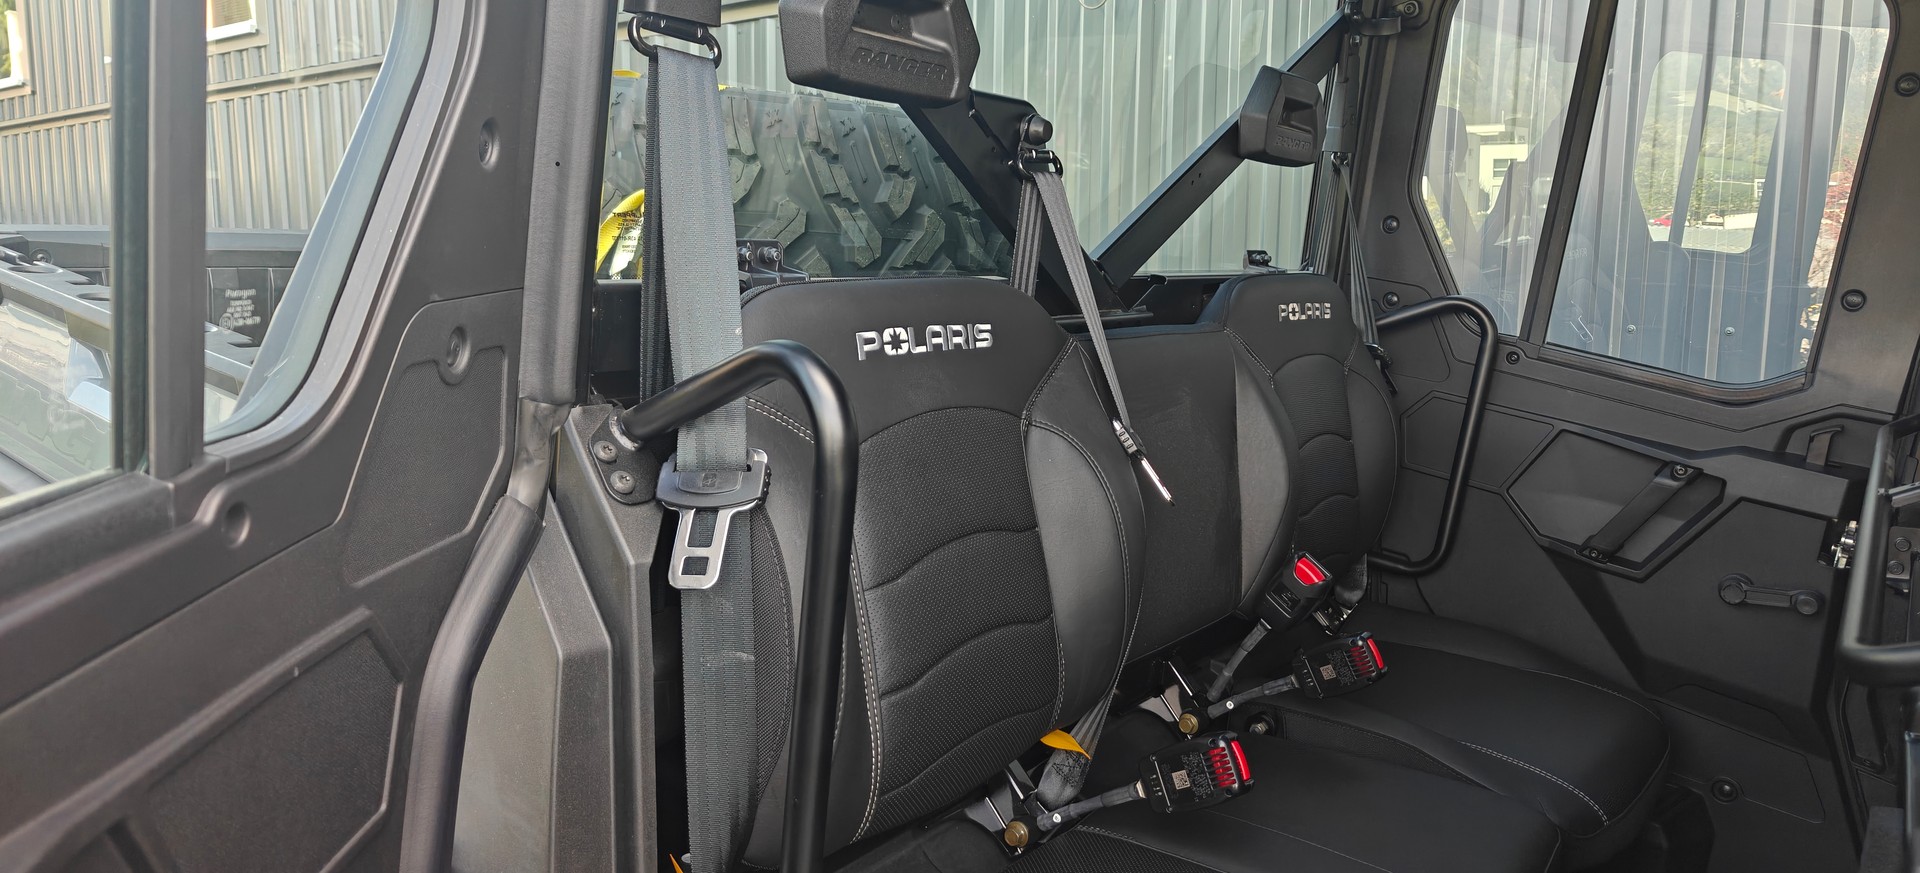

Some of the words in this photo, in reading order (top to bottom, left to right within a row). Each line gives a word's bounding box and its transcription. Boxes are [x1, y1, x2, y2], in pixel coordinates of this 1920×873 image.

[851, 46, 948, 80] RANGER
[1278, 302, 1331, 322] POLARIS
[856, 323, 993, 361] POLARIS
